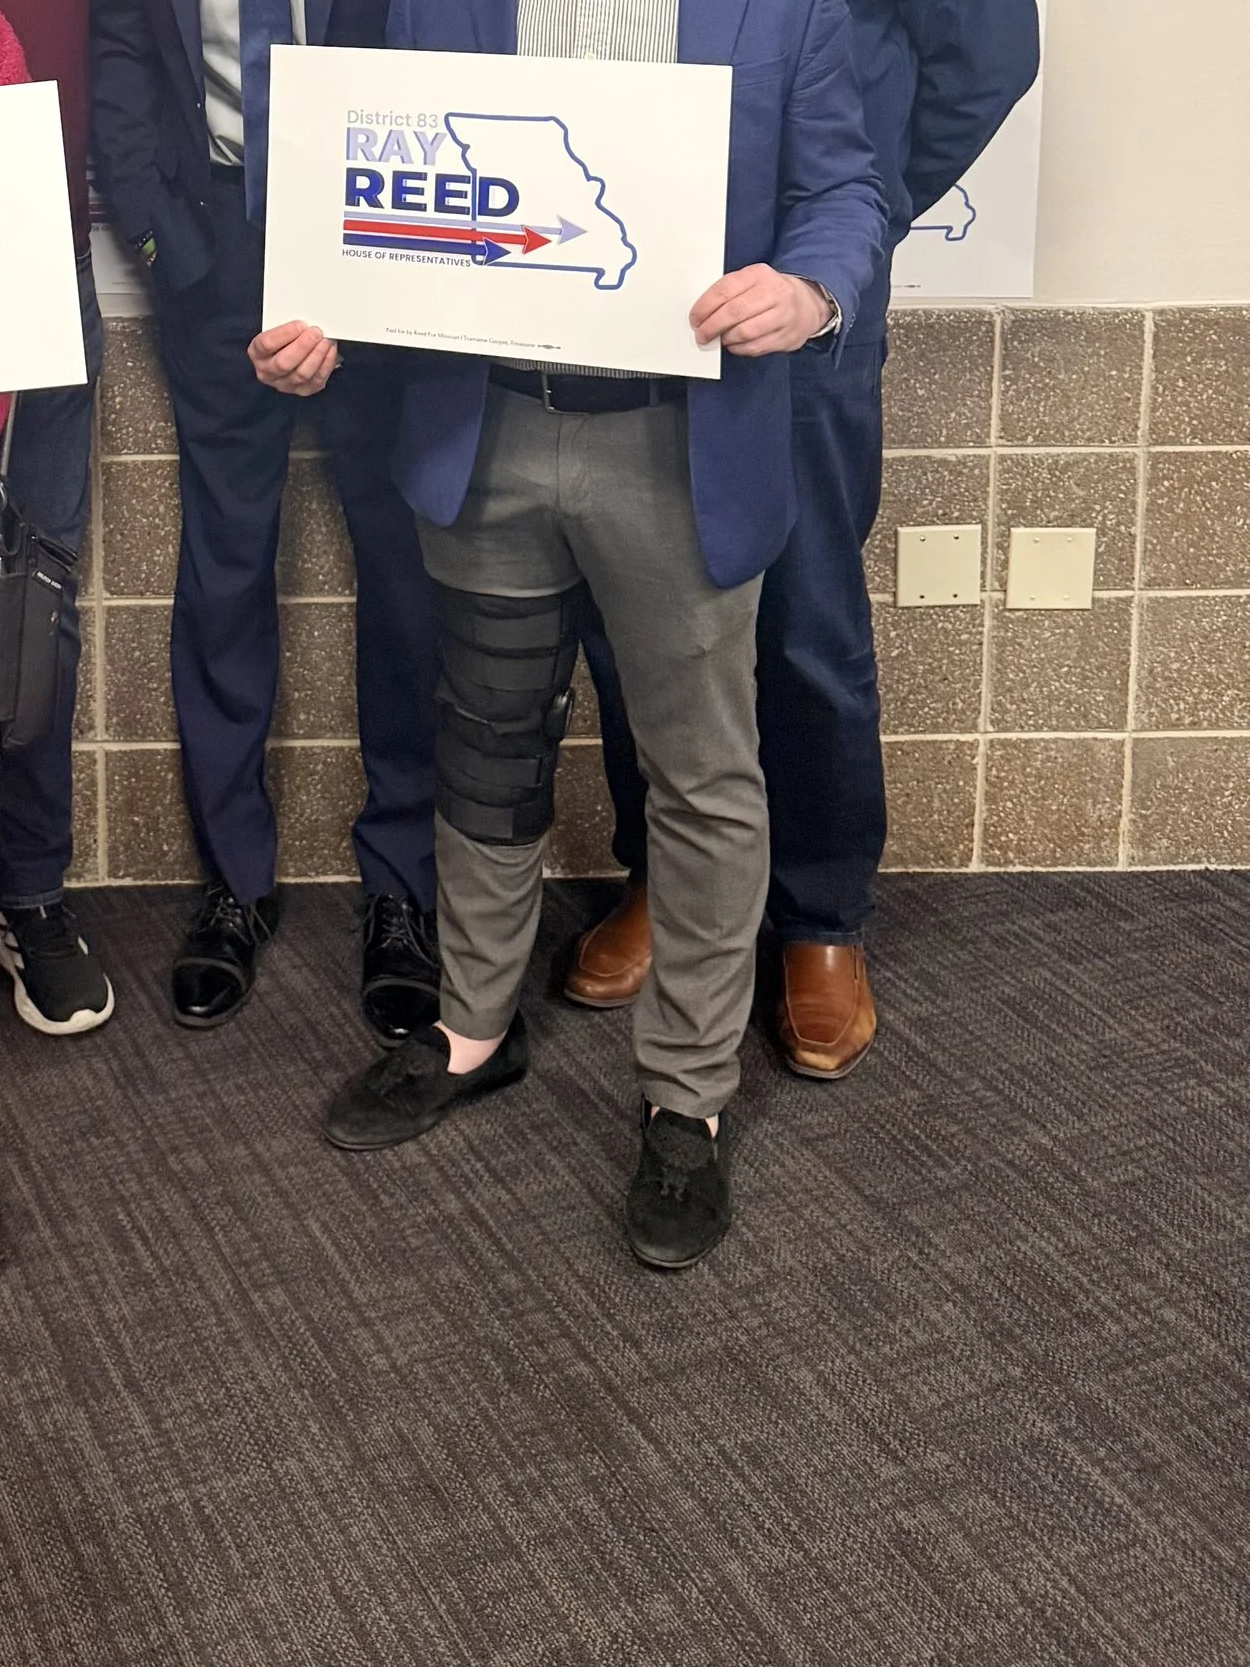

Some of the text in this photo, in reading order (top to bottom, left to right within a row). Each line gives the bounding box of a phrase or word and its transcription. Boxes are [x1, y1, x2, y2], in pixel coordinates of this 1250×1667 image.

[347, 110, 438, 128] District 83
[346, 127, 447, 166] RAY
[345, 167, 520, 218] REED
[342, 249, 372, 258] HOUSE
[389, 252, 471, 267] REPRESENTATIVES
